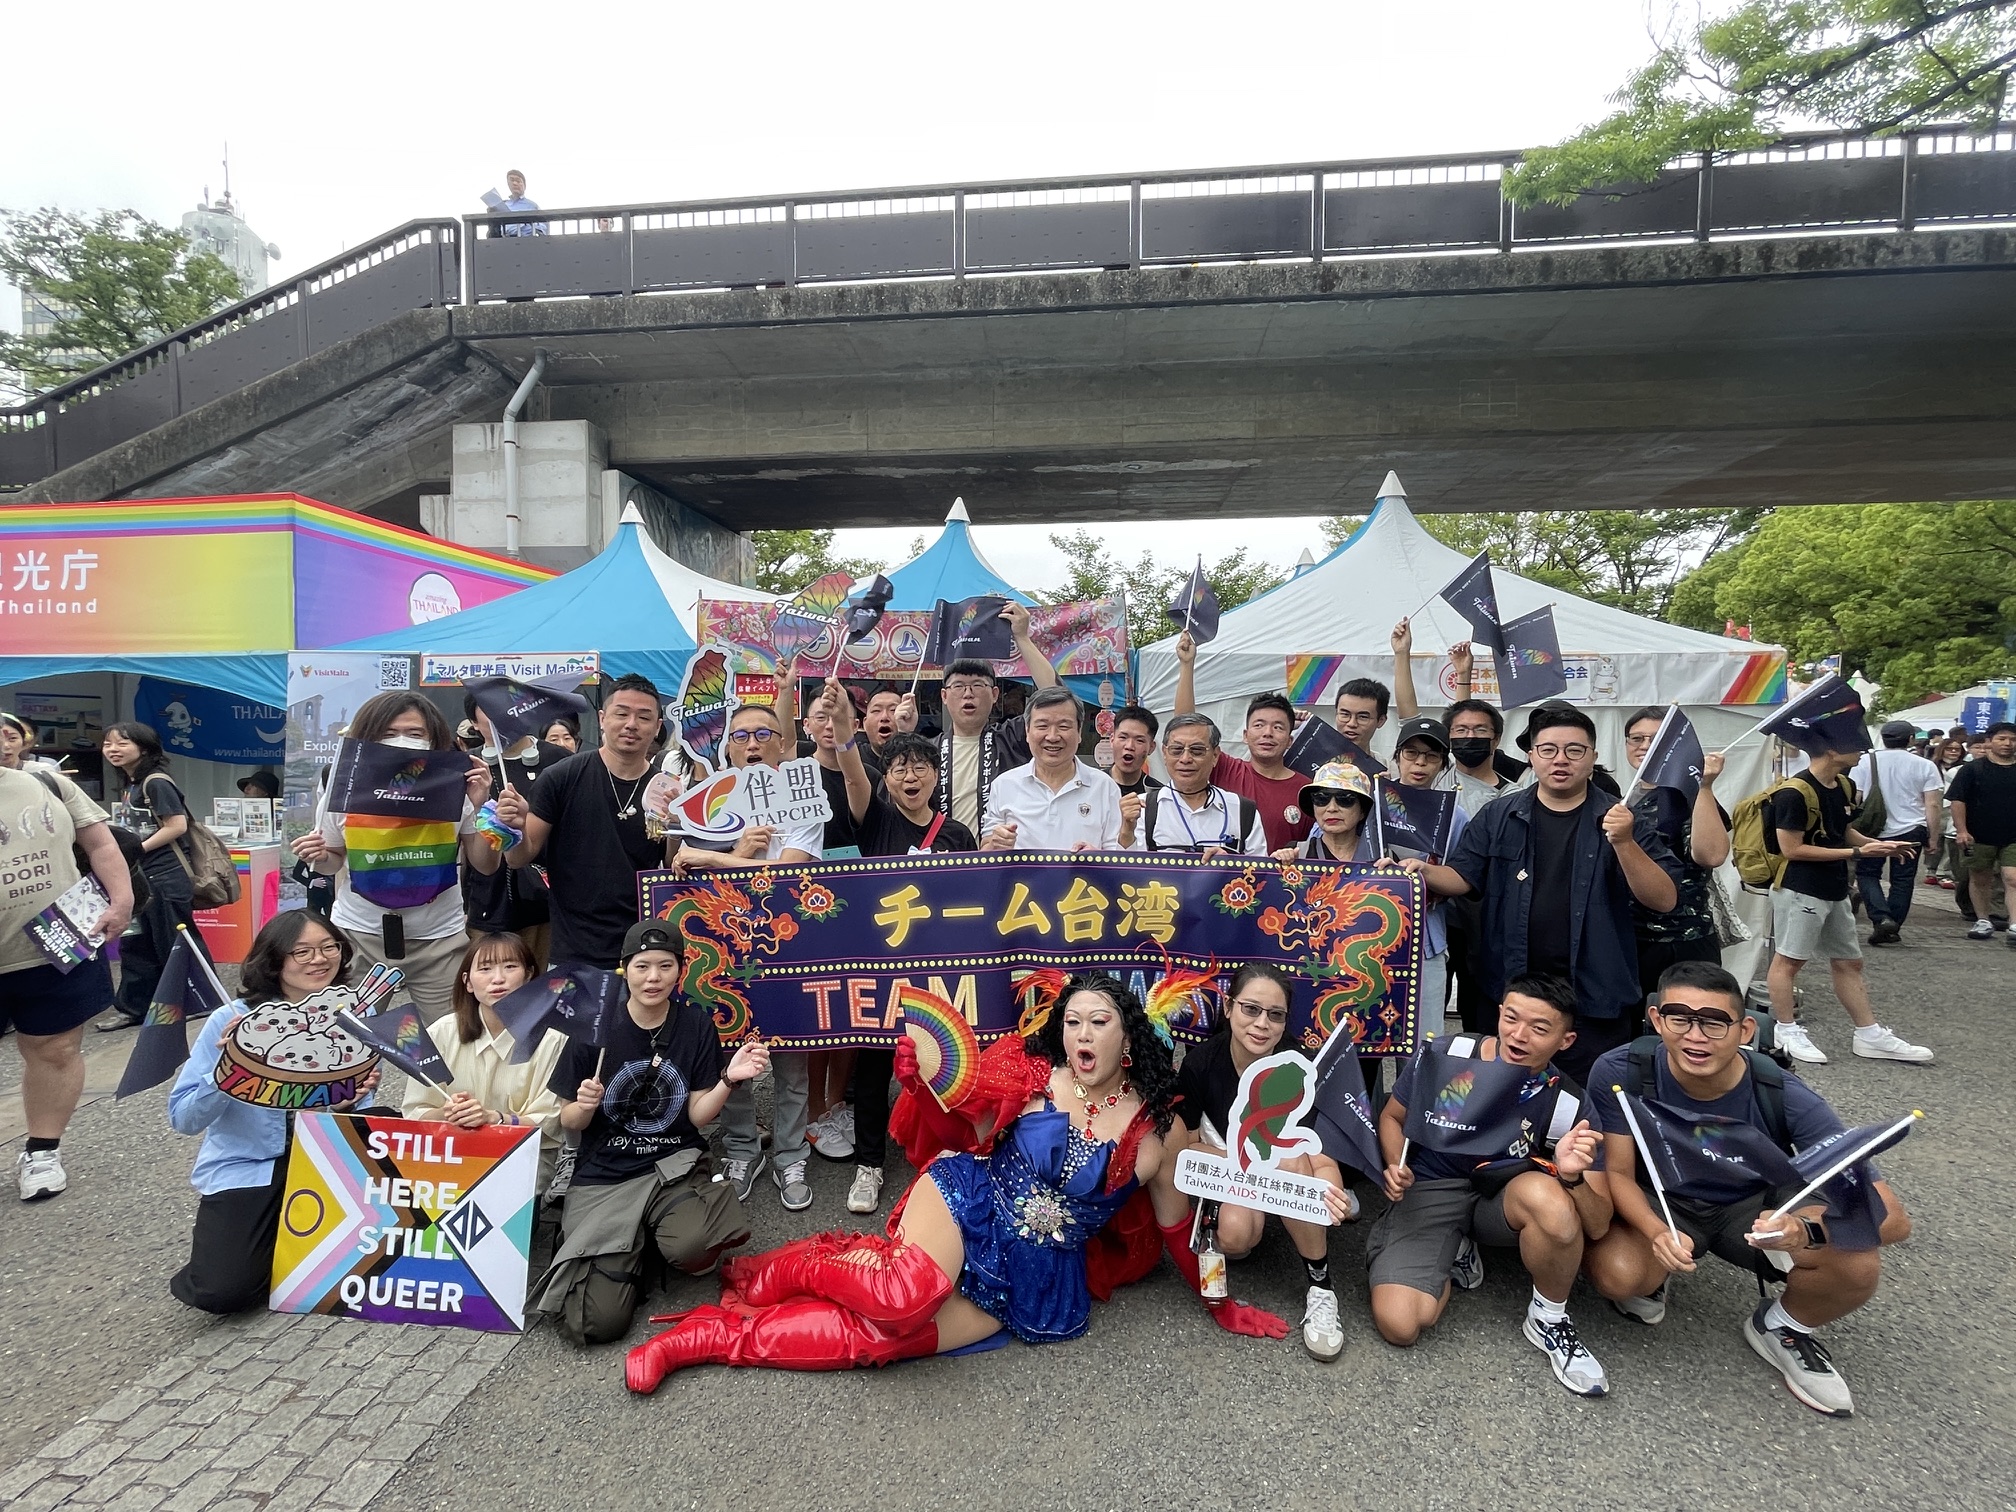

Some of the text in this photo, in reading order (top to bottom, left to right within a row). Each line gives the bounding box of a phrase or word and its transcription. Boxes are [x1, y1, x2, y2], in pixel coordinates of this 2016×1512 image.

[0, 549, 98, 591] 光庁
[775, 600, 839, 626] Taiwan
[1473, 596, 1498, 625] Taiwan
[512, 664, 541, 676] Visit
[546, 663, 584, 677] Malta
[1506, 643, 1518, 680] Taiwan
[671, 698, 735, 719] Taiwan
[1975, 701, 1992, 733] 東京
[373, 788, 425, 802] Taiwan
[743, 764, 821, 811] 伴盟
[750, 803, 826, 827] TAPCPR
[12, 850, 49, 866] STAR
[379, 850, 434, 862] VisitMalta
[9, 881, 53, 899] BIRDS
[874, 877, 1180, 947] チーム台湾
[33, 923, 73, 964] RAINBOW
[48, 927, 69, 950] REEL
[51, 920, 78, 948] TOKYO
[802, 974, 979, 1031] TEAM
[218, 1064, 357, 1109] TAIWAN
[1424, 1110, 1477, 1131] Taiwan
[366, 1130, 463, 1164] STILL
[363, 1176, 459, 1211] HERE
[1184, 1174, 1328, 1217] Taiwan AIDS Foundation
[357, 1225, 455, 1261] STILL
[339, 1274, 464, 1313] QUEER
